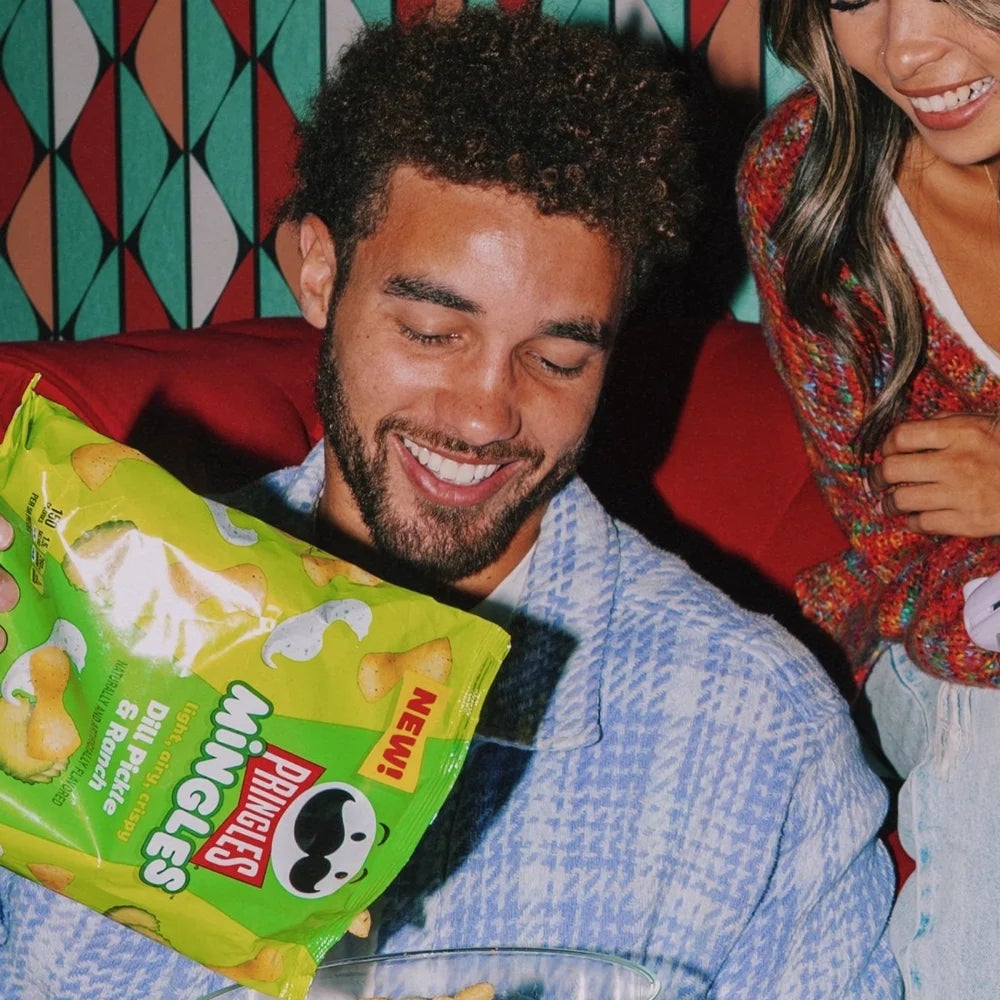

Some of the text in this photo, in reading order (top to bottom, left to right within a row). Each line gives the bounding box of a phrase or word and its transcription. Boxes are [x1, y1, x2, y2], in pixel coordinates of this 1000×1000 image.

[28, 492, 39, 507] PER
[92, 703, 105, 723] AND
[98, 660, 128, 707] NATURALLY
[88, 698, 139, 791] & Ranch
[103, 699, 170, 816] Dill Pickle
[117, 701, 199, 842] light, airy, crispy
[376, 686, 438, 781] NEW!
[52, 766, 84, 807] FLAVORED
[204, 751, 312, 878] PRINGLES
